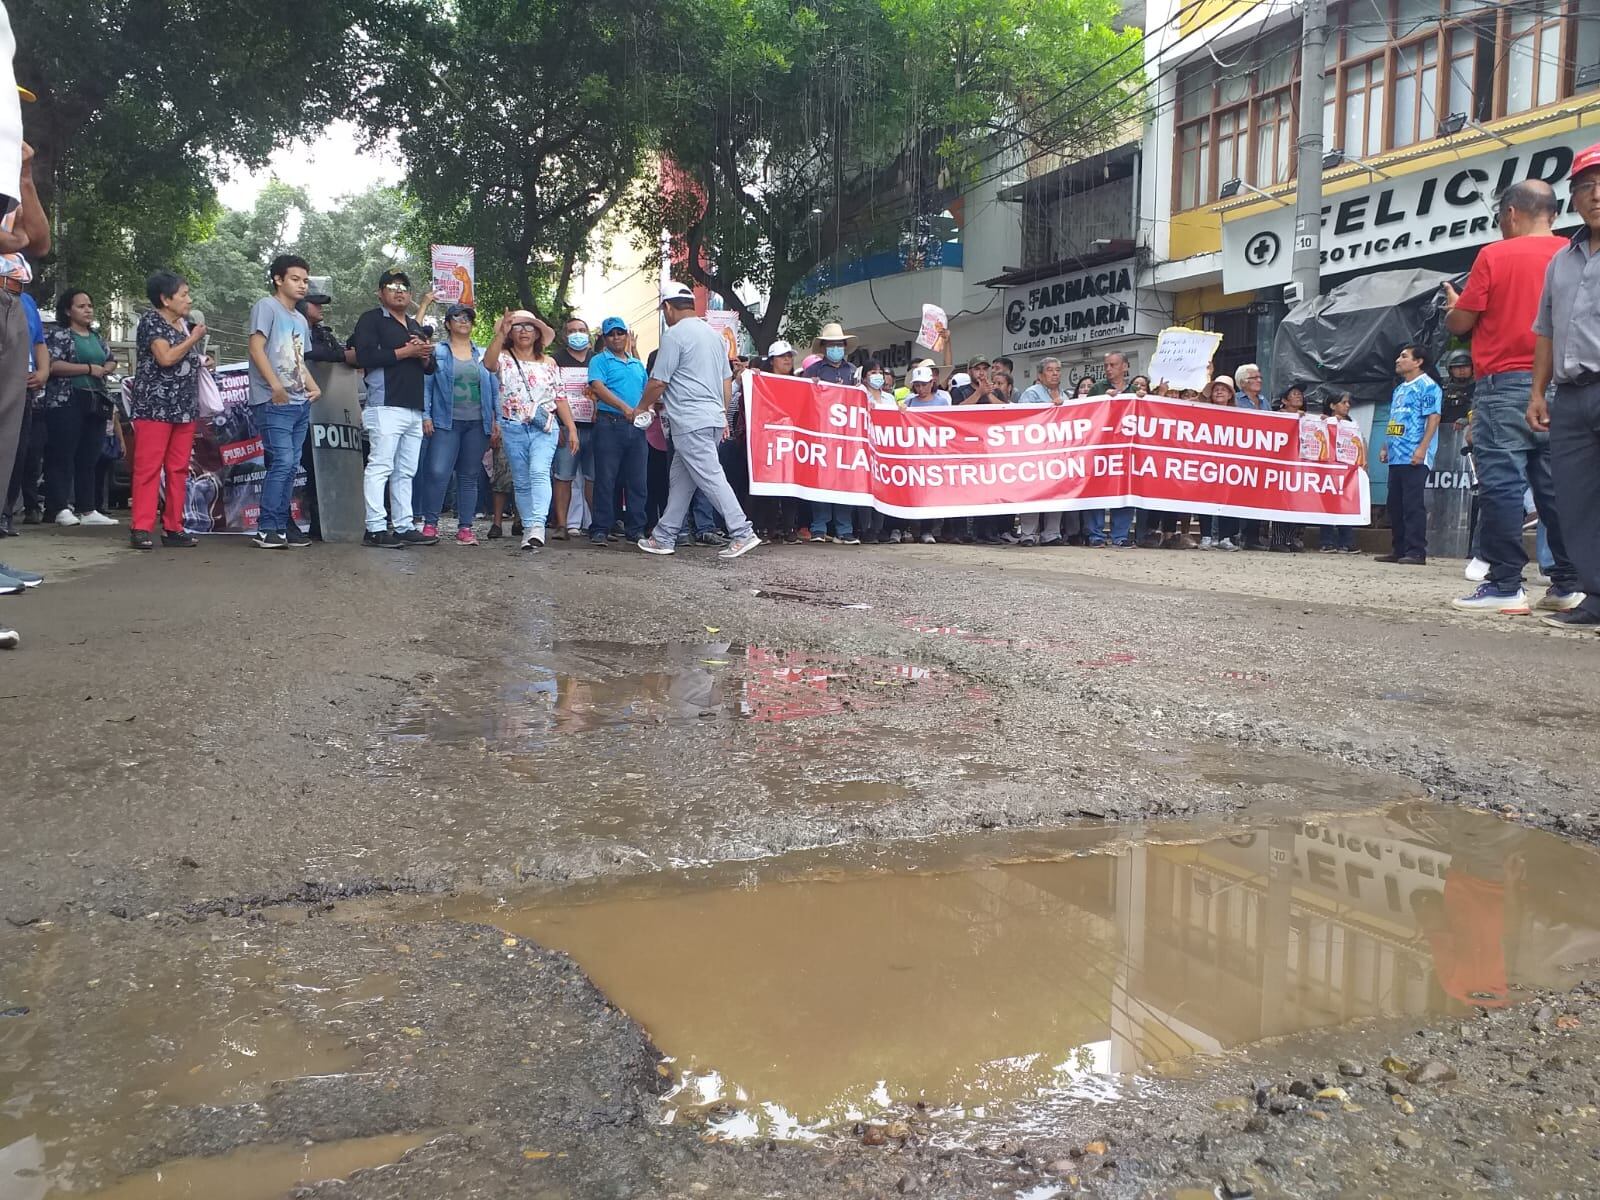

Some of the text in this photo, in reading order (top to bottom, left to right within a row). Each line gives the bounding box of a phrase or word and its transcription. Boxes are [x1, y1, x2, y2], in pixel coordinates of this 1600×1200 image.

[1028, 268, 1132, 312] FARMACIA
[1029, 302, 1130, 338] SOLIDARIA
[1013, 339, 1046, 351] Cuidando
[1050, 336, 1059, 345] Tu
[1059, 332, 1078, 344] Salud
[986, 418, 1092, 447] STOMP
[1120, 414, 1289, 453] SUTRAMUNP
[766, 436, 828, 468] ¡POR
[836, 446, 871, 472] LA
[1094, 454, 1124, 477] DE
[1131, 453, 1158, 479] LA
[1164, 457, 1258, 488] REGION
[1264, 467, 1346, 496] PIURA!
